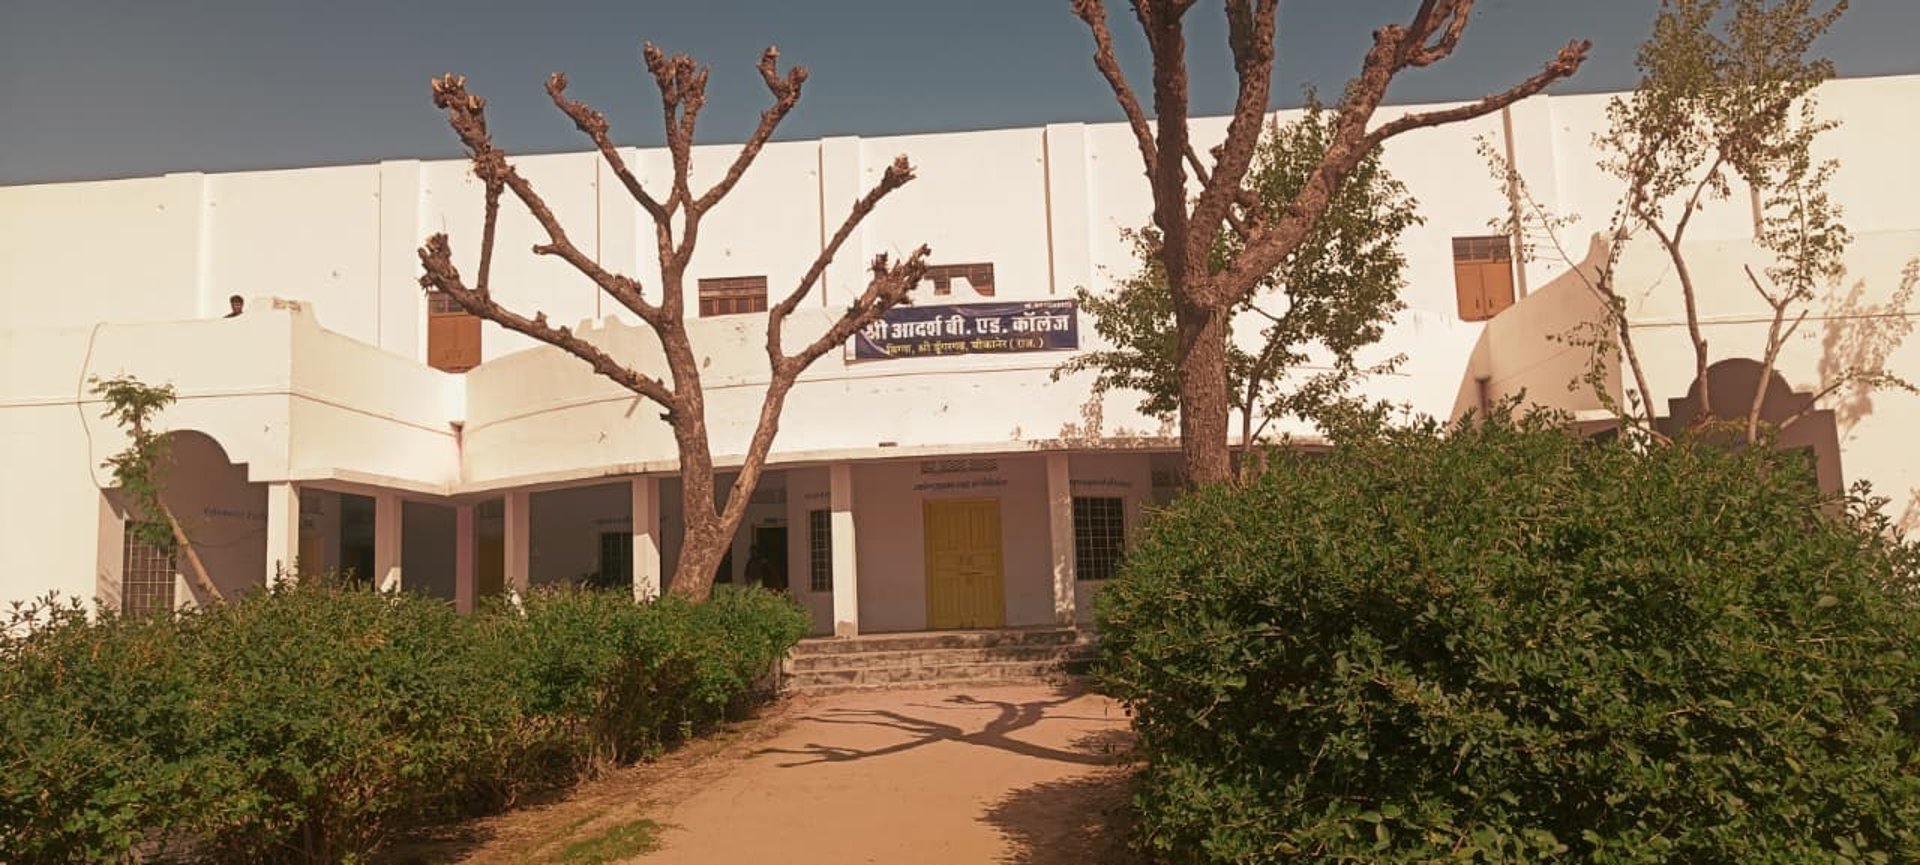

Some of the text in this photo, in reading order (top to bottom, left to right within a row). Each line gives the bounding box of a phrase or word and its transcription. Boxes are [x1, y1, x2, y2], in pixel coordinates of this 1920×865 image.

[866, 311, 1069, 340] श्री आदर्श बी. एड. कॉलेज
[918, 341, 931, 352] श्री
[970, 337, 1008, 349] बीकानेर
